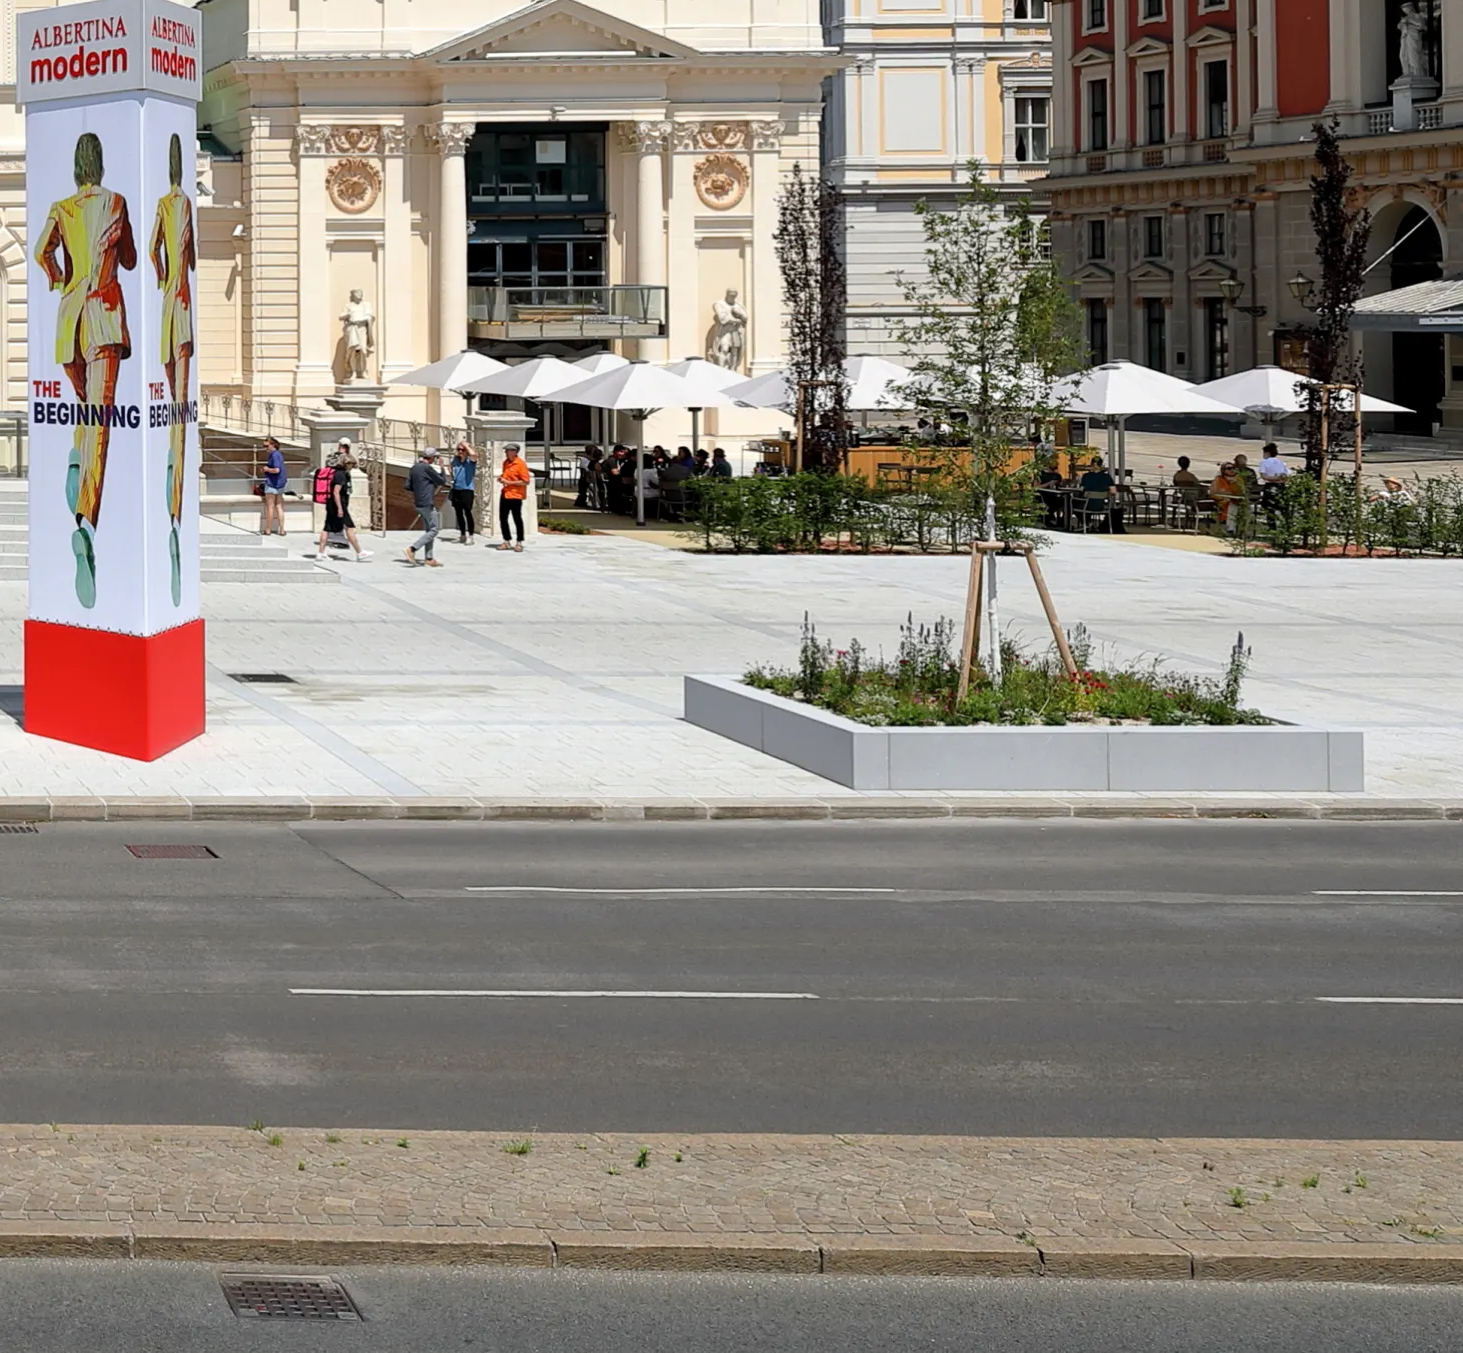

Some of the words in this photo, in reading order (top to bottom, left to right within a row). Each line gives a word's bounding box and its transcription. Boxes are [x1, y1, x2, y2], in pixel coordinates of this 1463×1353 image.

[31, 15, 127, 50] ALBERTINA
[152, 15, 196, 49] ALBERTINA
[30, 46, 128, 84] modern
[151, 46, 197, 82] modern
[33, 380, 61, 398] THE
[149, 382, 165, 401] THE
[34, 402, 141, 429] BEGINNING
[150, 400, 198, 428] BEGINNING
